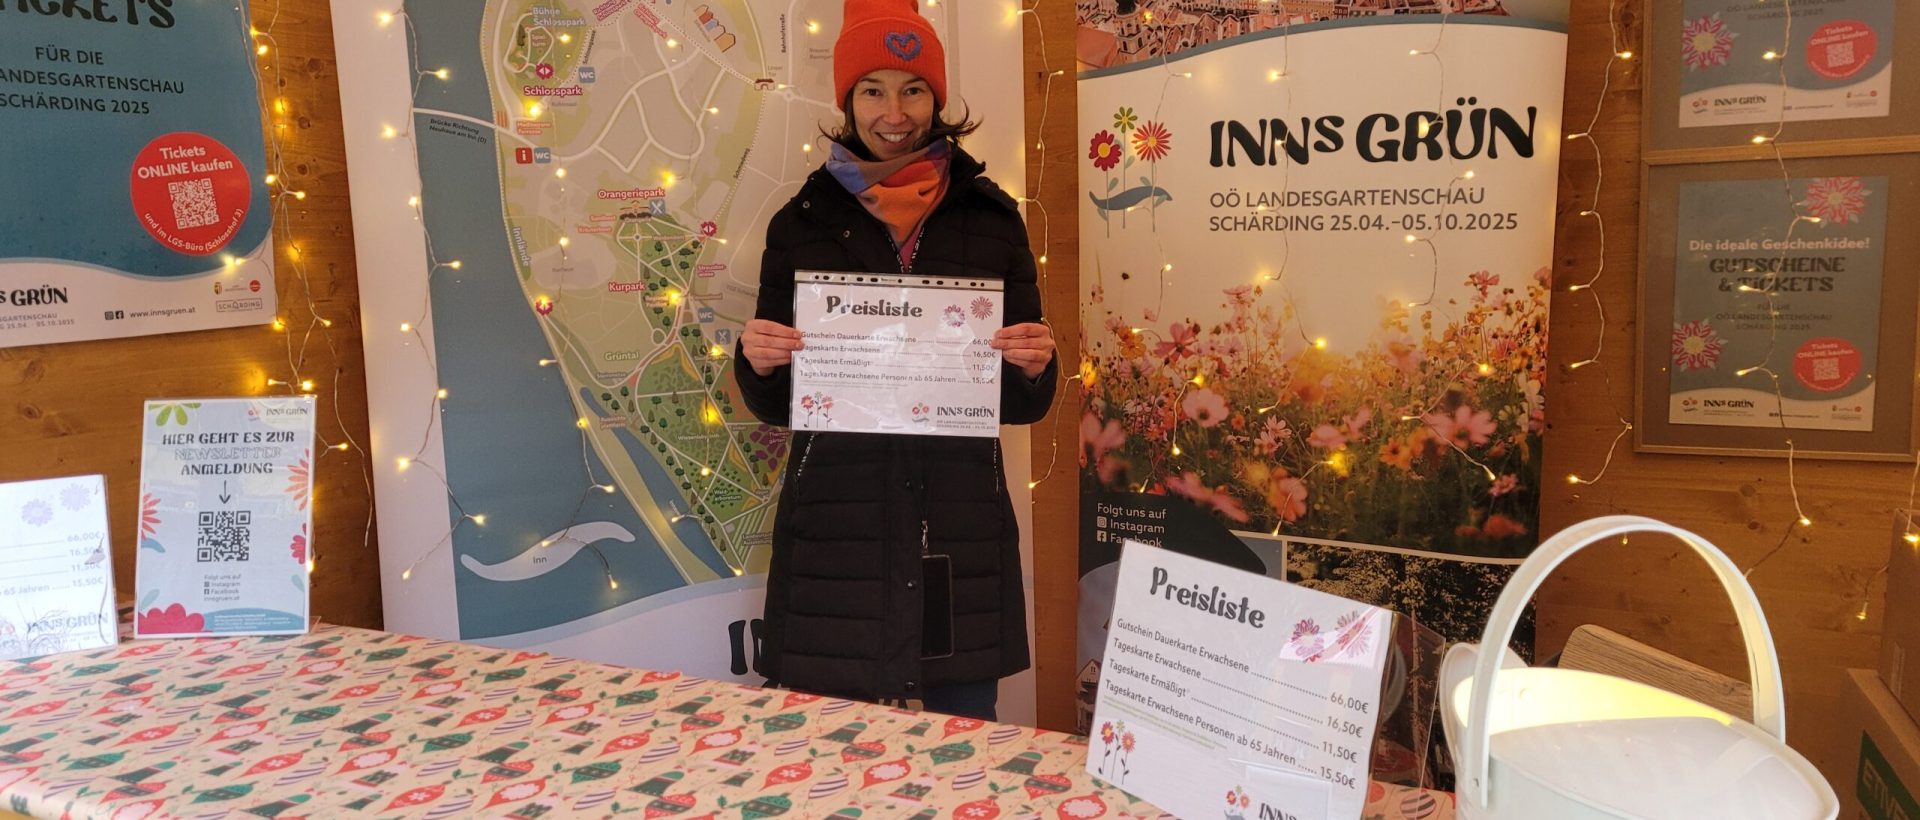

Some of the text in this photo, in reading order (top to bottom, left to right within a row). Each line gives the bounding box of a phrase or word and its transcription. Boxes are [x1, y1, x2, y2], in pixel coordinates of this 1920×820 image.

[0, 0, 175, 28] CKETS
[533, 7, 560, 15] Bühne
[533, 18, 585, 27] Schlosspark
[35, 45, 104, 65] FÜR DIE
[524, 86, 582, 97] Schlosspark
[0, 92, 149, 114] SCHÄRDING 2025
[430, 119, 479, 134] Brücke Richtung
[1356, 97, 1537, 163] GRÜN
[160, 146, 206, 159] Tickets
[535, 152, 549, 160] WC
[138, 159, 233, 178] ONLINE kaufen
[598, 188, 665, 200] Orangeriepark
[1209, 186, 1485, 208] OÖ LANDESGARTENSCHAU
[1208, 210, 1324, 233] SCHÄRDING
[144, 208, 244, 252] und im LGS-Büro (Schlosshof 3)
[513, 227, 530, 266] Innlände
[1690, 238, 1870, 252] Die ideale Geschenkidee!
[1709, 257, 1845, 273] GUTSCHEINE
[609, 282, 645, 292] Kurpark
[1718, 276, 1834, 292] & TICKETS
[10, 284, 68, 306] GRÜN
[130, 307, 196, 318] www.innsgruen.at
[826, 295, 923, 318] Preisliste
[0, 313, 57, 322] GARTENSCHAU
[837, 333, 875, 341] Dauerkarte
[972, 338, 992, 347] 66,00
[605, 352, 639, 360] Grüntal
[804, 344, 838, 353] ageskarte
[840, 346, 880, 354] Erwachsene
[800, 357, 838, 365] Tageskarte
[839, 371, 879, 380] Erwachsene
[934, 375, 956, 383] Jahren
[964, 406, 995, 417] GRÜN
[162, 431, 295, 445] HIER GEHT ES ZUR
[174, 446, 281, 461] NEWSLETTER
[181, 463, 273, 476] ANMELDUNG
[1097, 503, 1166, 519] Folgt uns auf
[1110, 519, 1165, 534] Instagram
[1110, 533, 1162, 547] Fabook
[70, 547, 103, 556] 16,50
[532, 556, 547, 564] Inn
[1150, 567, 1265, 628] Preisliste
[1117, 618, 1368, 714] Gutschein Dauerkarte Erwachsene 66,00€
[1113, 637, 1363, 738] Tageskarte Erwachsene 16,50€
[1109, 658, 1150, 682] Tageskarte
[1322, 741, 1357, 763] 11,50€
[1105, 679, 1146, 704] Tageskarte
[1147, 696, 1194, 725] Erwachsene
[1195, 716, 1235, 741] Personen
[1237, 735, 1248, 747] ab
[1249, 738, 1262, 752] 65
[1263, 744, 1296, 765] Jahren
[1320, 766, 1356, 789] 15,50€
